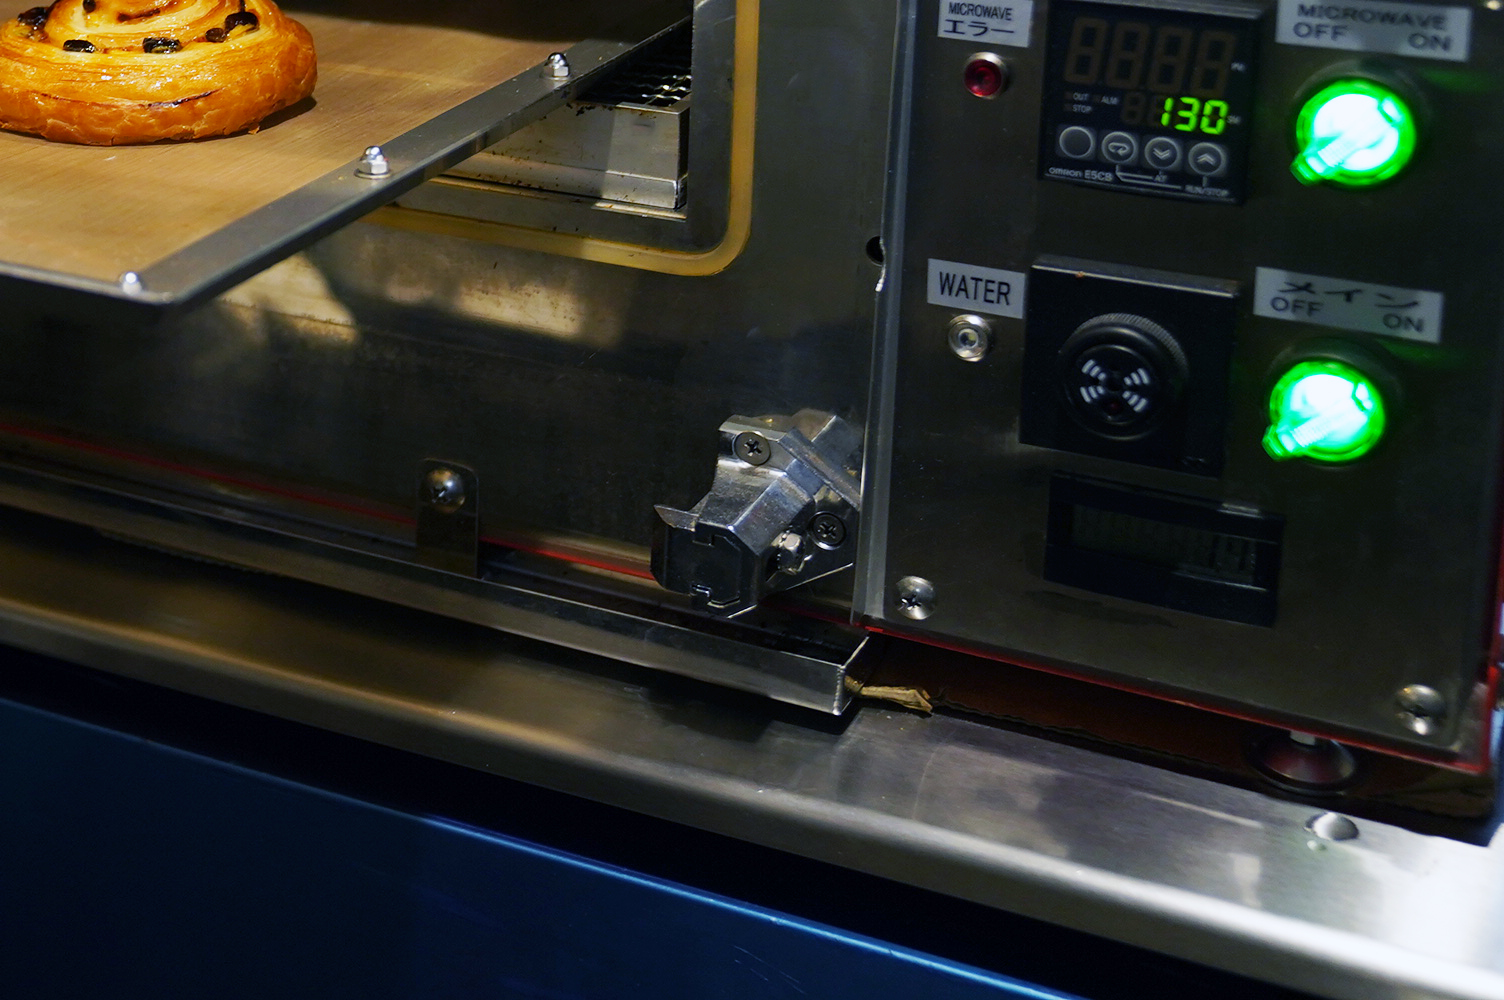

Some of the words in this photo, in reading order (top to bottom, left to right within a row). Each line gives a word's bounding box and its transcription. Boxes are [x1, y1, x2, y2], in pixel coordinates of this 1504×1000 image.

[948, 1, 1013, 21] MICROWAVE
[1297, 2, 1449, 32] MICROWAVE
[943, 18, 1015, 37] エラー
[1293, 21, 1347, 42] OFF
[1410, 32, 1452, 53] ON
[1073, 104, 1092, 114] STOP
[1161, 96, 1229, 135] 130
[1049, 167, 1082, 178] omron
[939, 270, 1012, 307] WATER
[1275, 281, 1419, 311] メイン
[1271, 296, 1324, 318] OFF
[1383, 313, 1424, 333] ON
